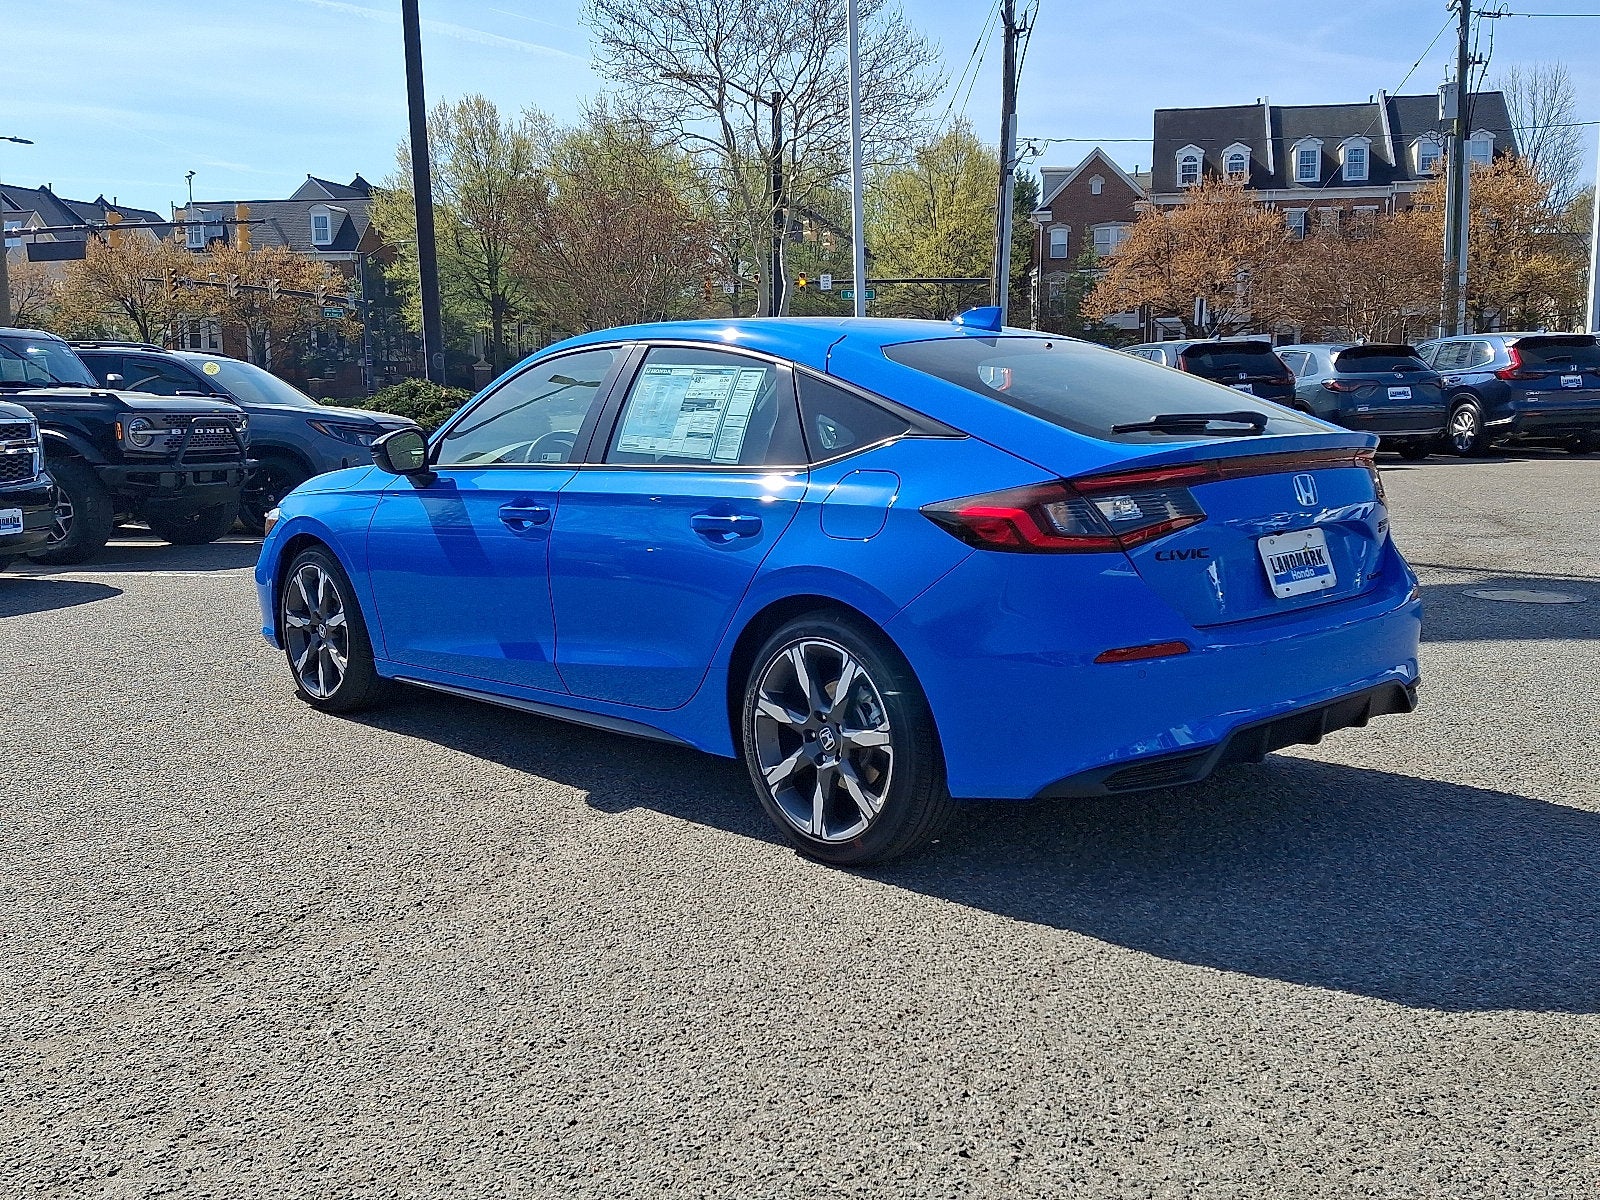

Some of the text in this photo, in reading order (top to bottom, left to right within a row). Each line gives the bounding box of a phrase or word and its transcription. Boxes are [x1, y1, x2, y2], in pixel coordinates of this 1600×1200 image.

[1154, 547, 1210, 562] CIVIC
[1269, 548, 1325, 574] LANDMARK
[1291, 565, 1315, 580] Honda
